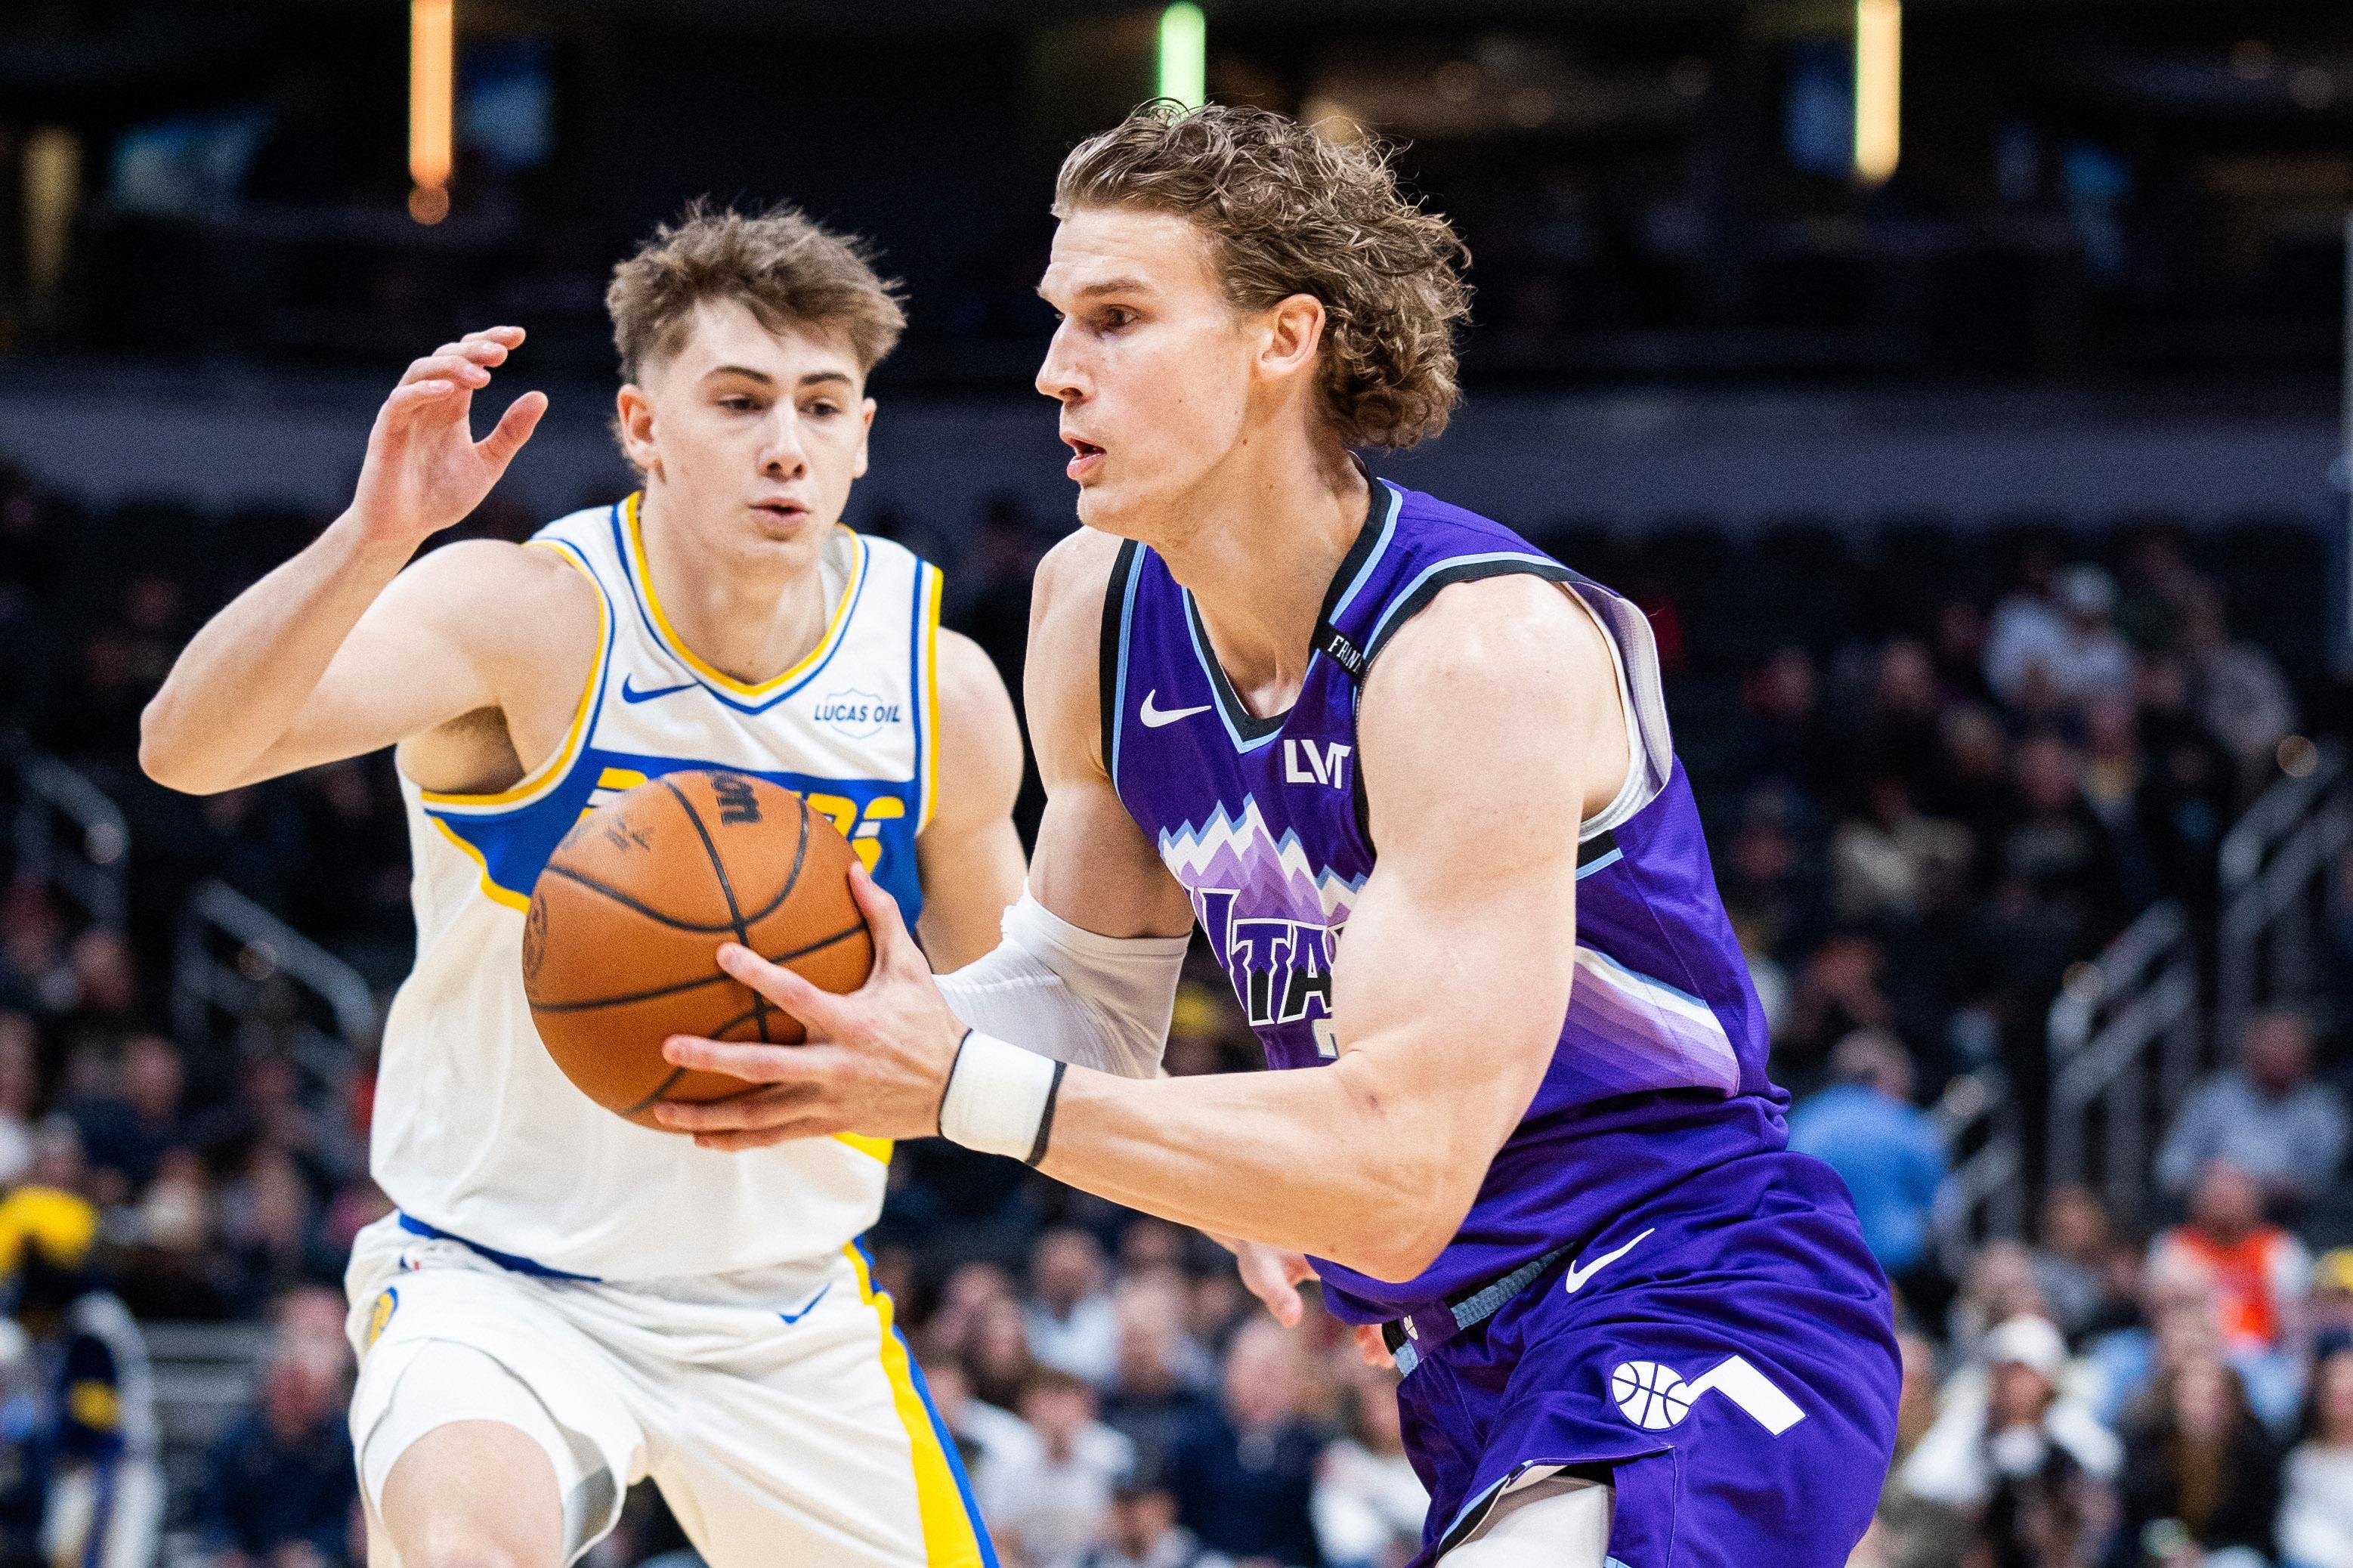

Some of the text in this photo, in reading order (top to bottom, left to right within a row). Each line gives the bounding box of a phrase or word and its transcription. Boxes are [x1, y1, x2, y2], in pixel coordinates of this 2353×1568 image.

[814, 704, 901, 722] LUCAS OIL
[1284, 739, 1352, 790] LVT
